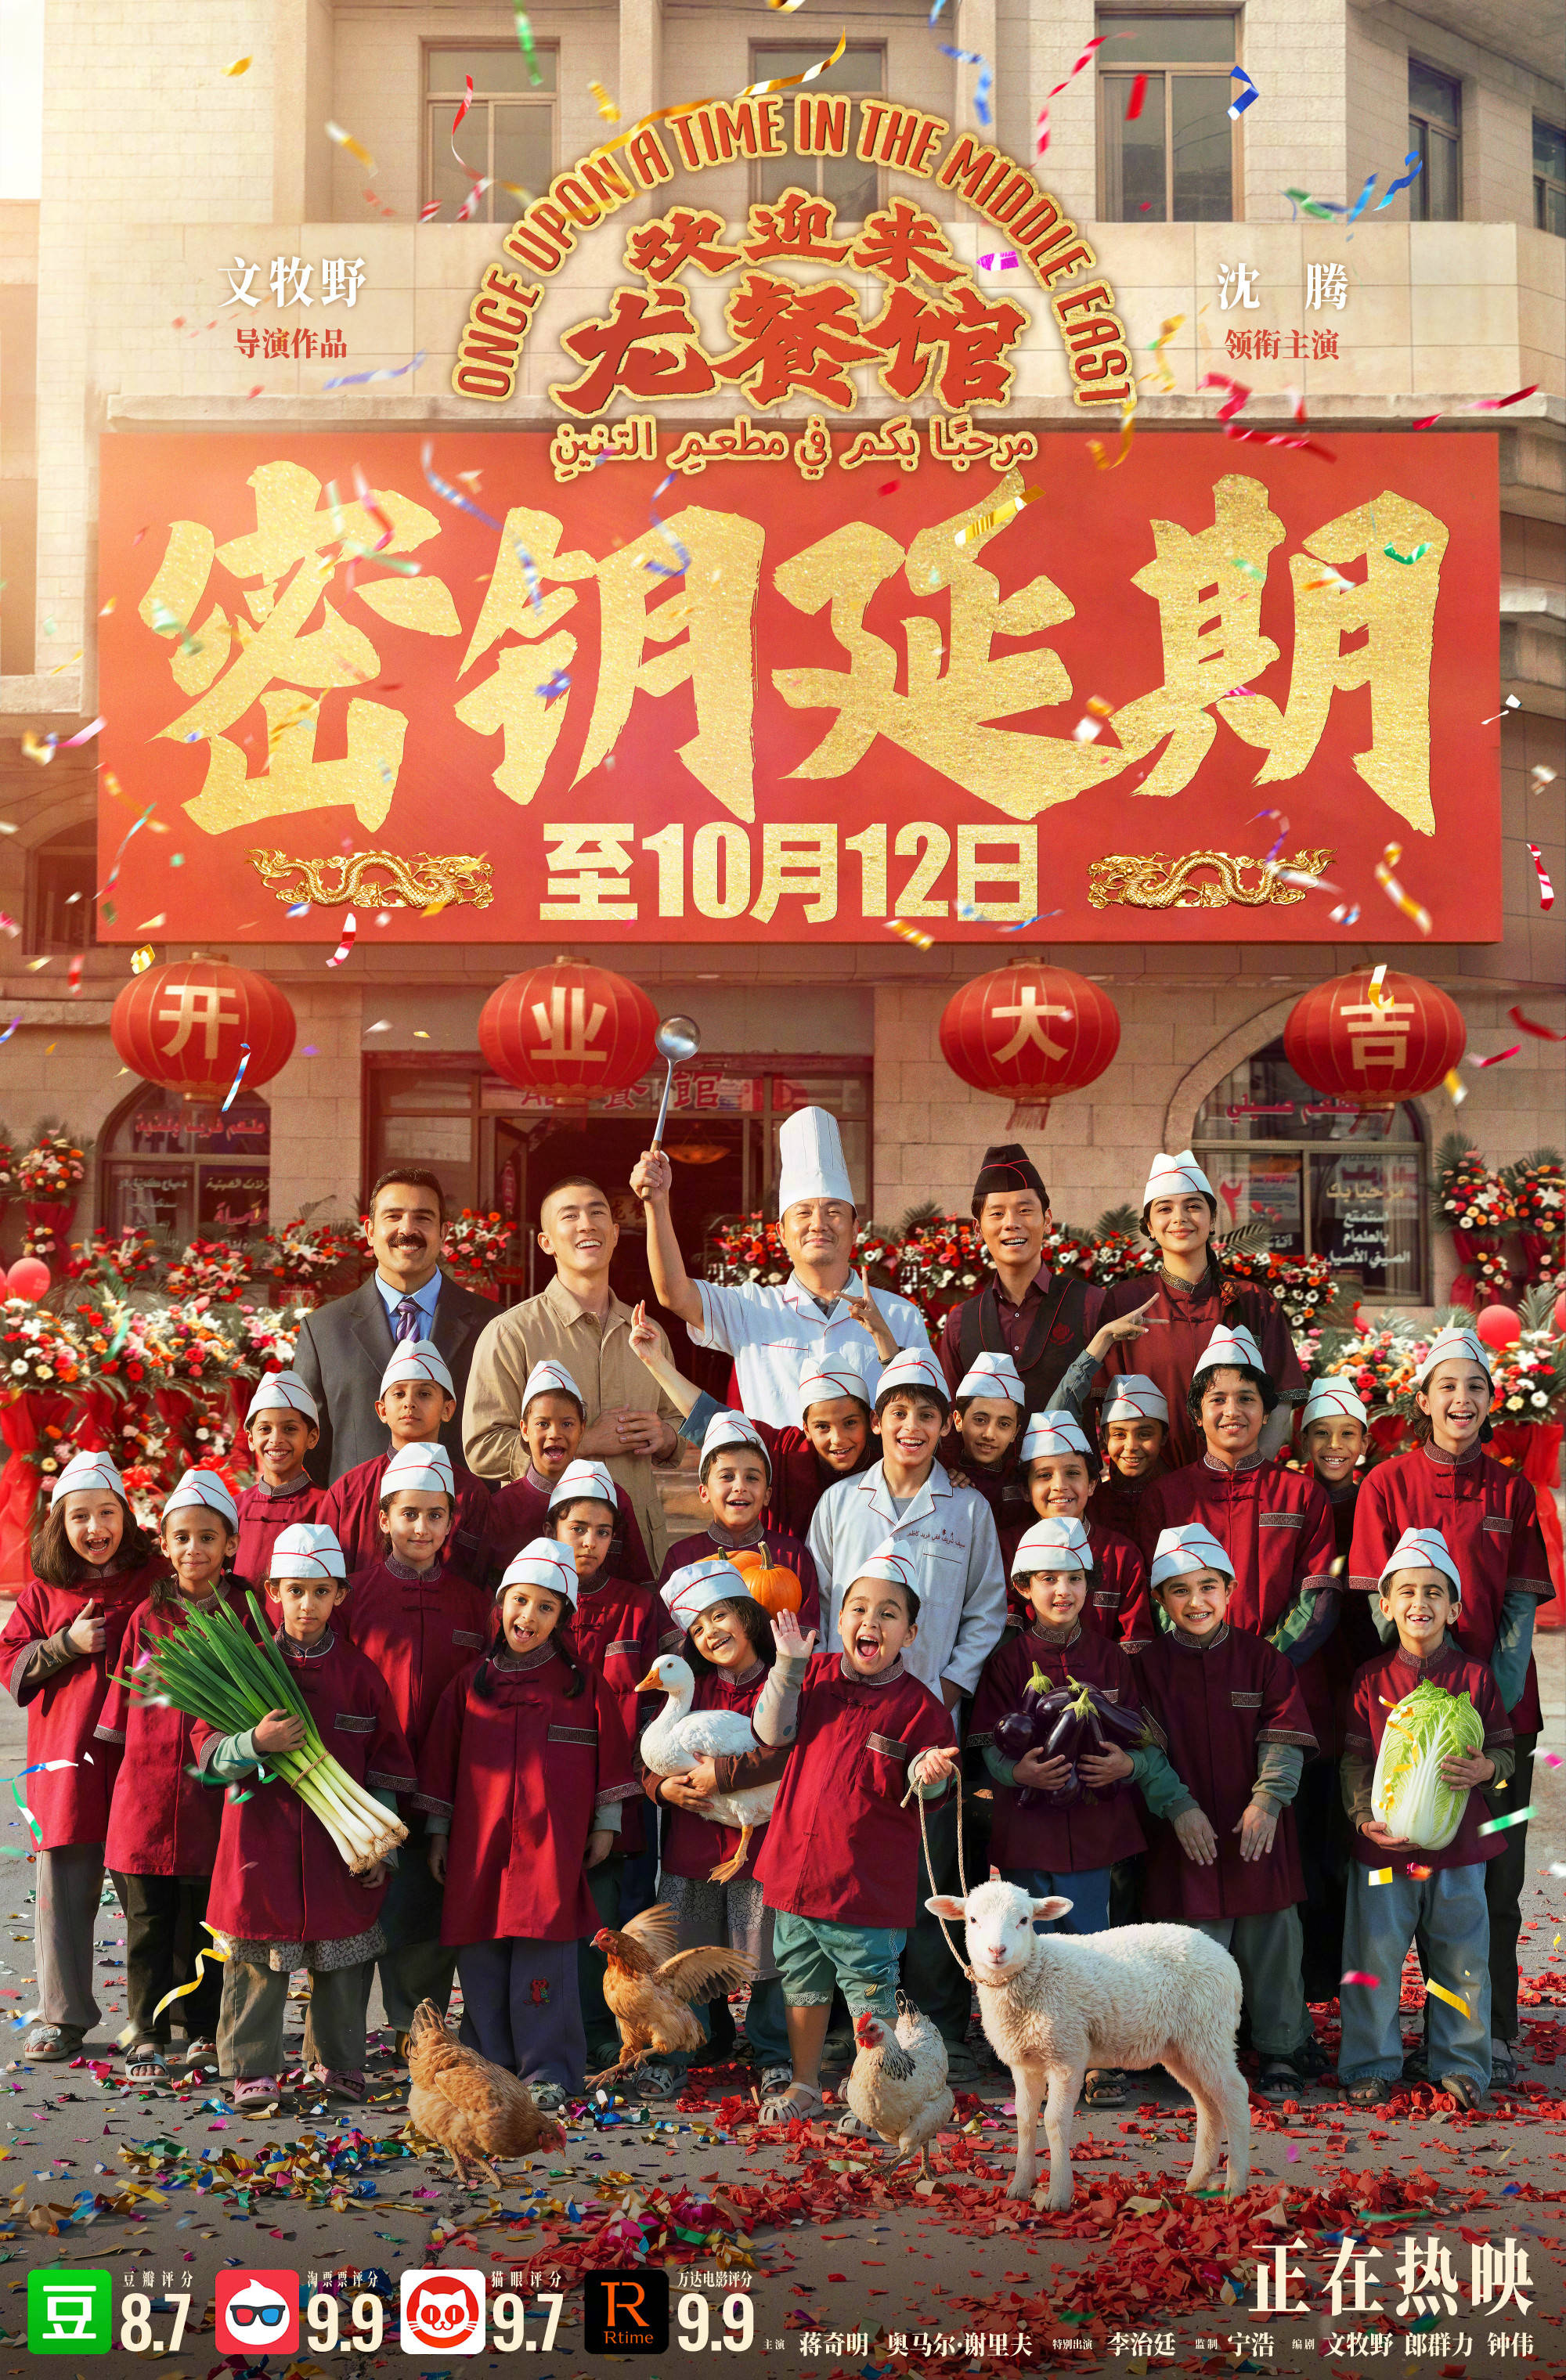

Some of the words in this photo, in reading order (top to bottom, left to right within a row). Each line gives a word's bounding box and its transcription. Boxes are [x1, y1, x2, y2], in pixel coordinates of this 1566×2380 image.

[138, 460, 1449, 836] 密钥延期
[539, 821, 1038, 924] 至10月12日
[159, 984, 240, 1060] 开
[530, 986, 608, 1062] 业
[991, 986, 1070, 1064] 大
[1340, 993, 1415, 1070] 吉
